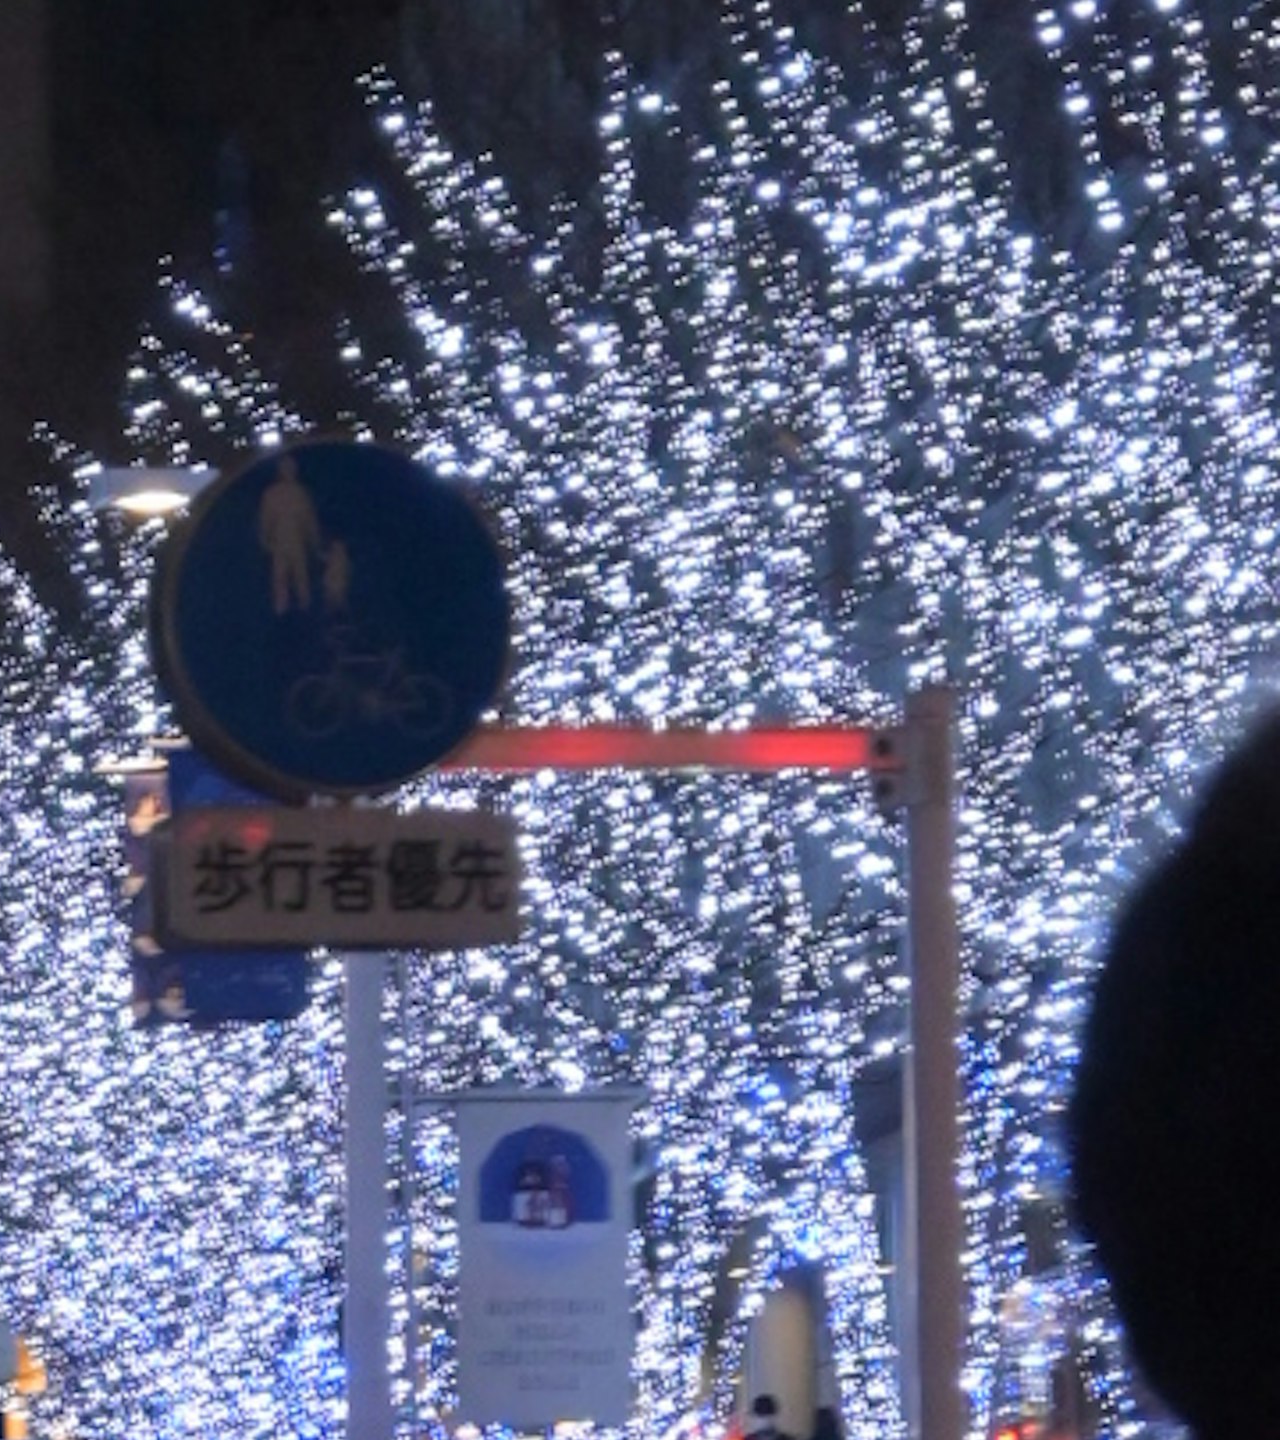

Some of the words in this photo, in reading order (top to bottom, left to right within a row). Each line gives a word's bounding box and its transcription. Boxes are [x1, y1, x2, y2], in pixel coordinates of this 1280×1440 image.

[194, 839, 507, 911] 歩行者優先
